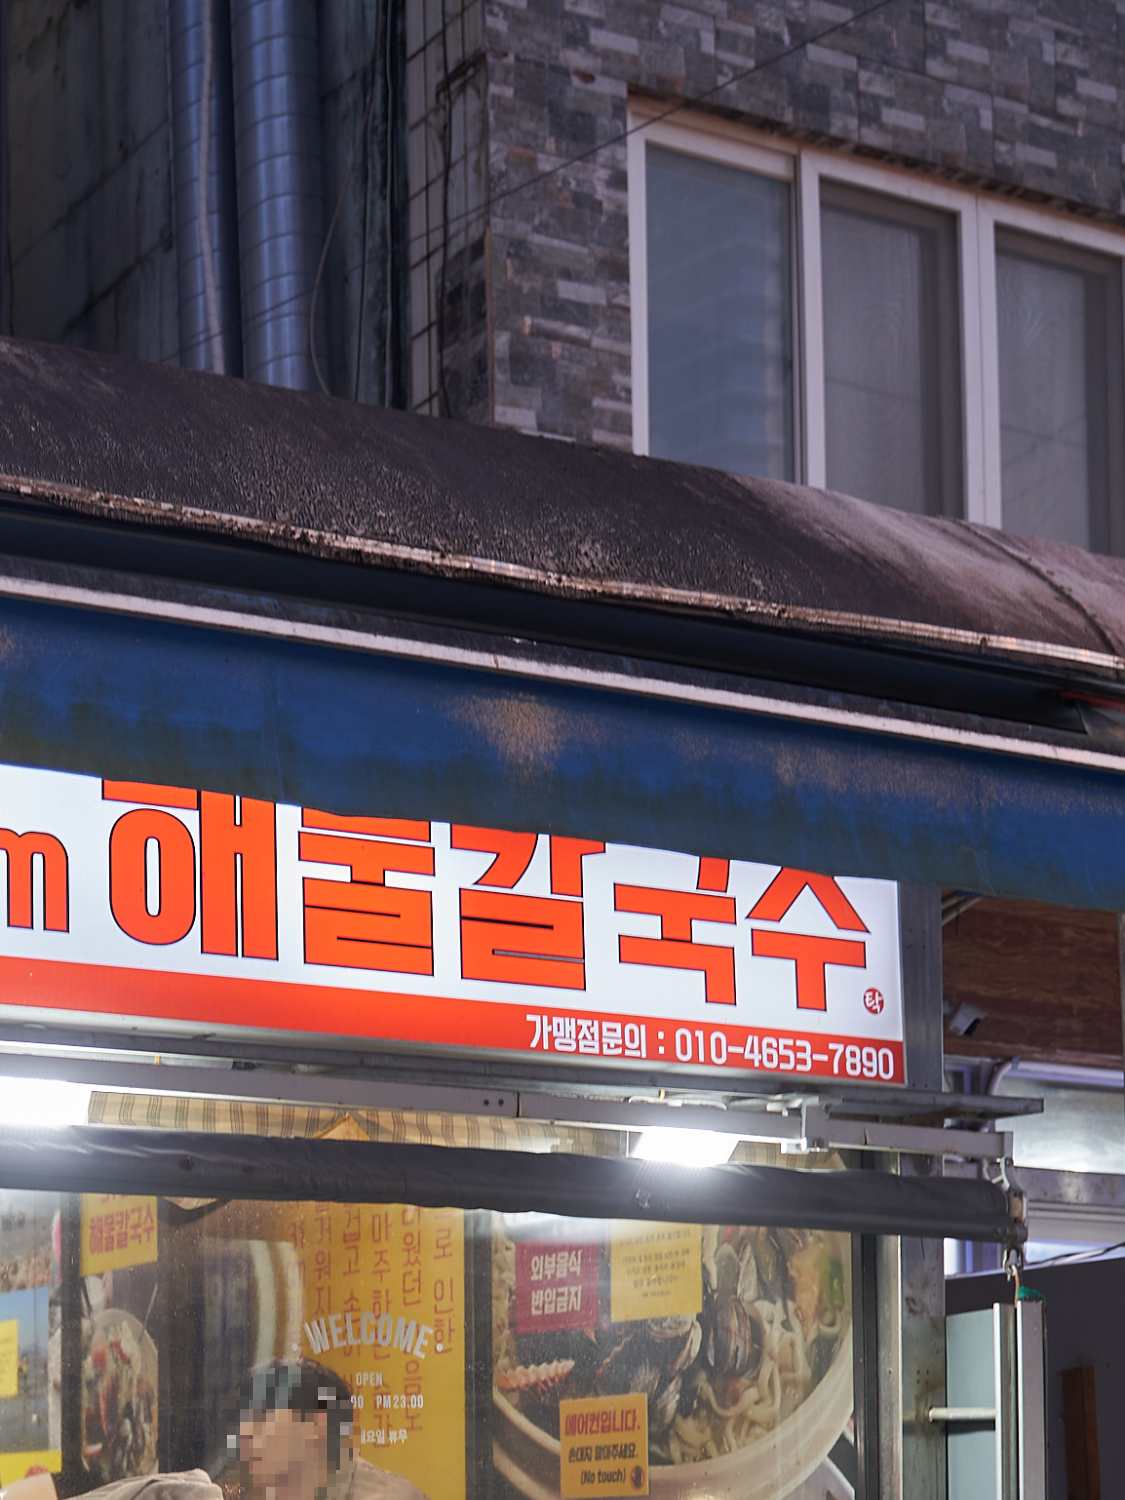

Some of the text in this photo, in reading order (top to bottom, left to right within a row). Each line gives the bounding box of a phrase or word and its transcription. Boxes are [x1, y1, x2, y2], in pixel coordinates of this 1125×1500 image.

[525, 1013, 647, 1061] 가맹점문의
[673, 1029, 895, 1081] 010-4653-7890
[530, 1249, 583, 1282] 외부음식
[530, 1284, 583, 1317] 반입금지
[303, 1311, 434, 1360] WELCOME
[355, 1371, 384, 1387] OPEN
[376, 1394, 392, 1410] PM
[393, 1394, 424, 1410] 23.00
[388, 1428, 409, 1444] 휴무
[564, 1408, 642, 1437] 에어컨입니다.
[580, 1467, 627, 1486] (No touch)
